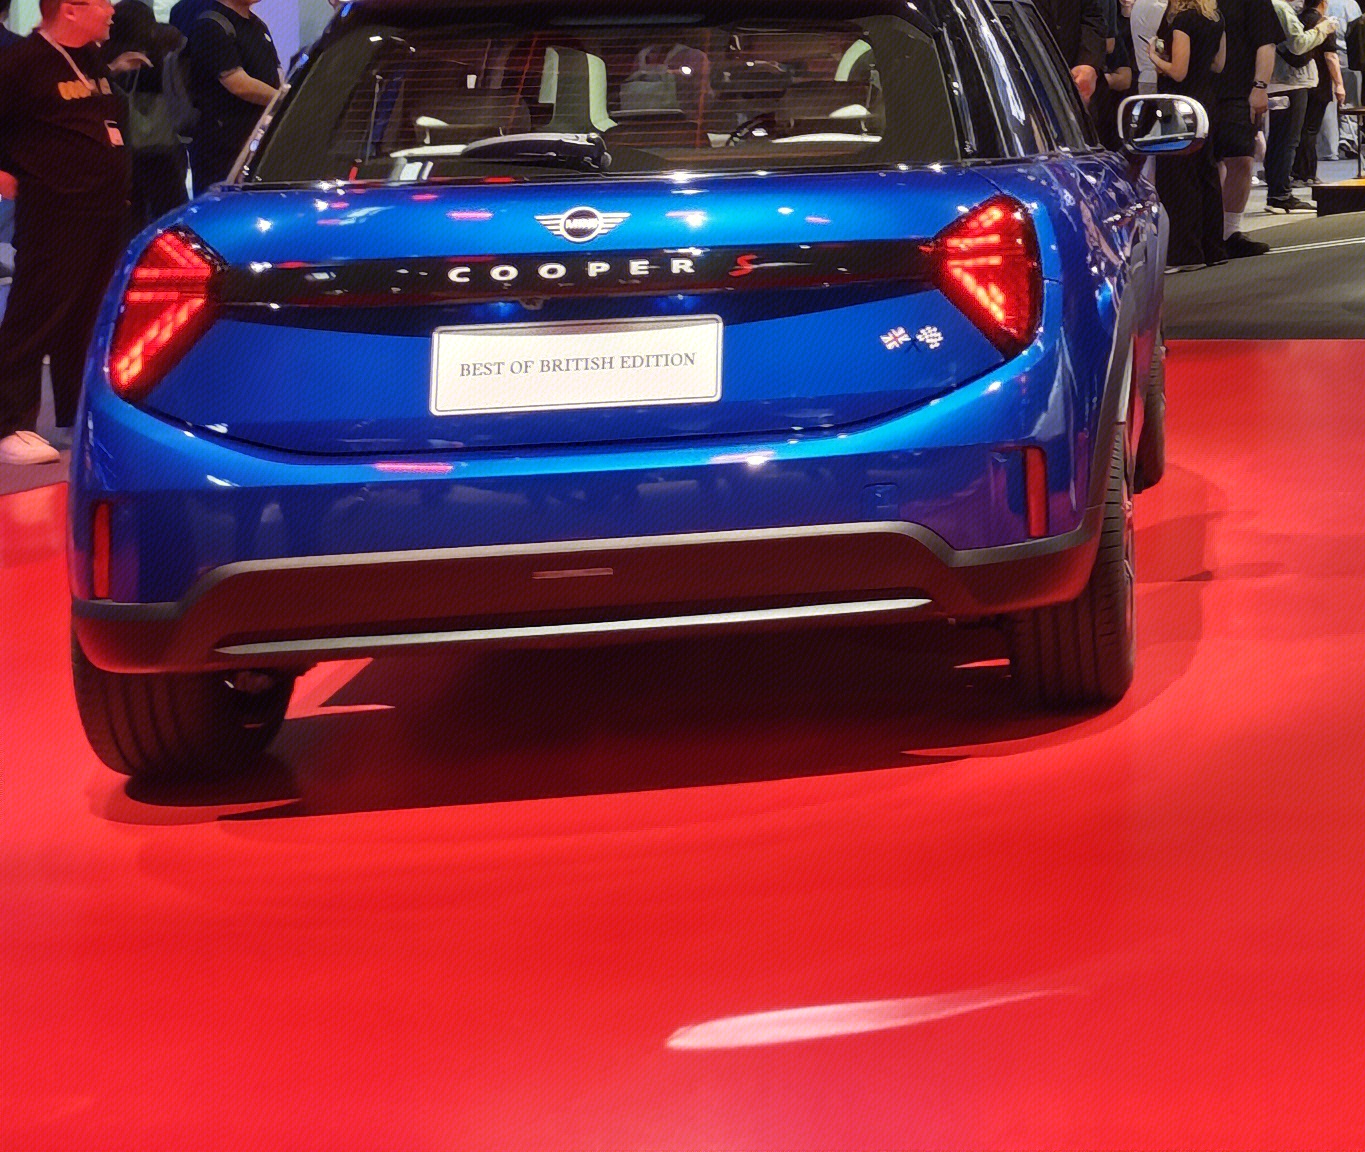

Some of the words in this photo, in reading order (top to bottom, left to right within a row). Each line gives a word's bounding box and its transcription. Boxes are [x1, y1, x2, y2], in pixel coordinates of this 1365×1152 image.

[447, 257, 696, 283] COOPER
[728, 254, 758, 277] S
[459, 361, 505, 378] BEST
[509, 360, 534, 375] OF
[539, 356, 614, 373] BRITISH
[620, 352, 696, 368] EDITION
